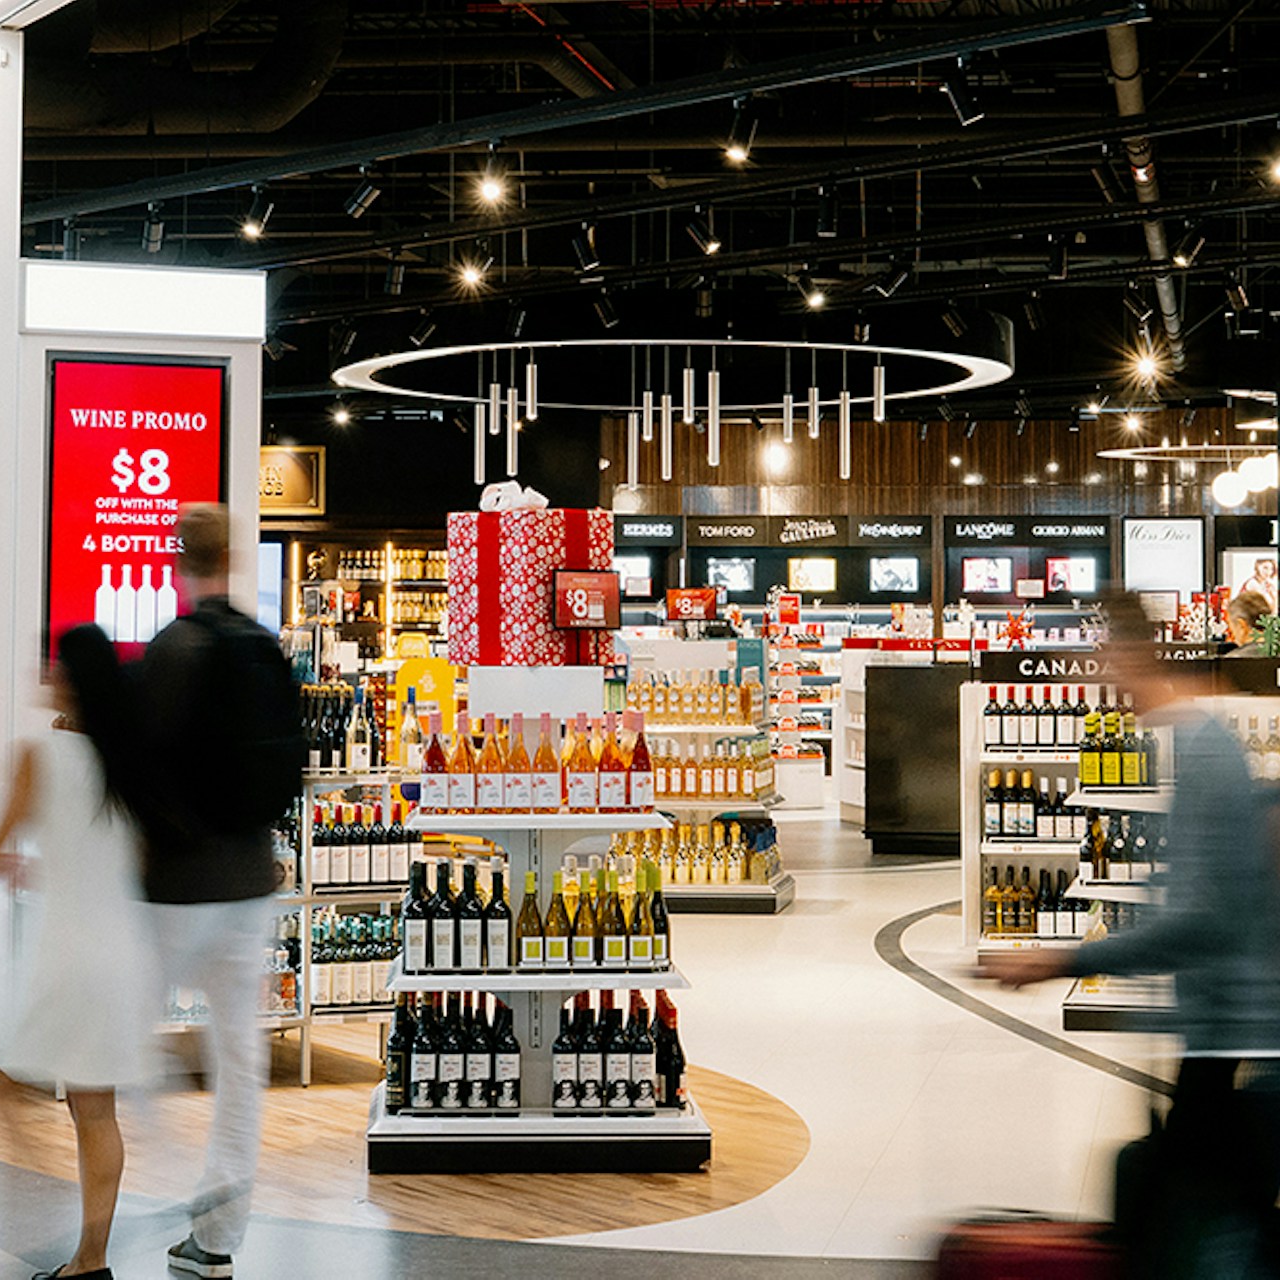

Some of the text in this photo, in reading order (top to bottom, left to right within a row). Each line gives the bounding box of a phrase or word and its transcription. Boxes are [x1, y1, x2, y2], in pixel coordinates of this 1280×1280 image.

[70, 409, 206, 431] WINE PROMO
[111, 447, 170, 495] $8
[95, 497, 178, 510] OFF WITH THE
[95, 513, 178, 526] PURCHASE OF
[699, 525, 756, 537] TOM FORD
[955, 522, 1015, 537] LANCÔME
[1032, 525, 1105, 536] GIORGIO ARMANI
[82, 534, 185, 553] 4 BOTTLES
[565, 588, 588, 618] $8
[675, 597, 693, 615] $8
[1019, 659, 1117, 677] CANADA
